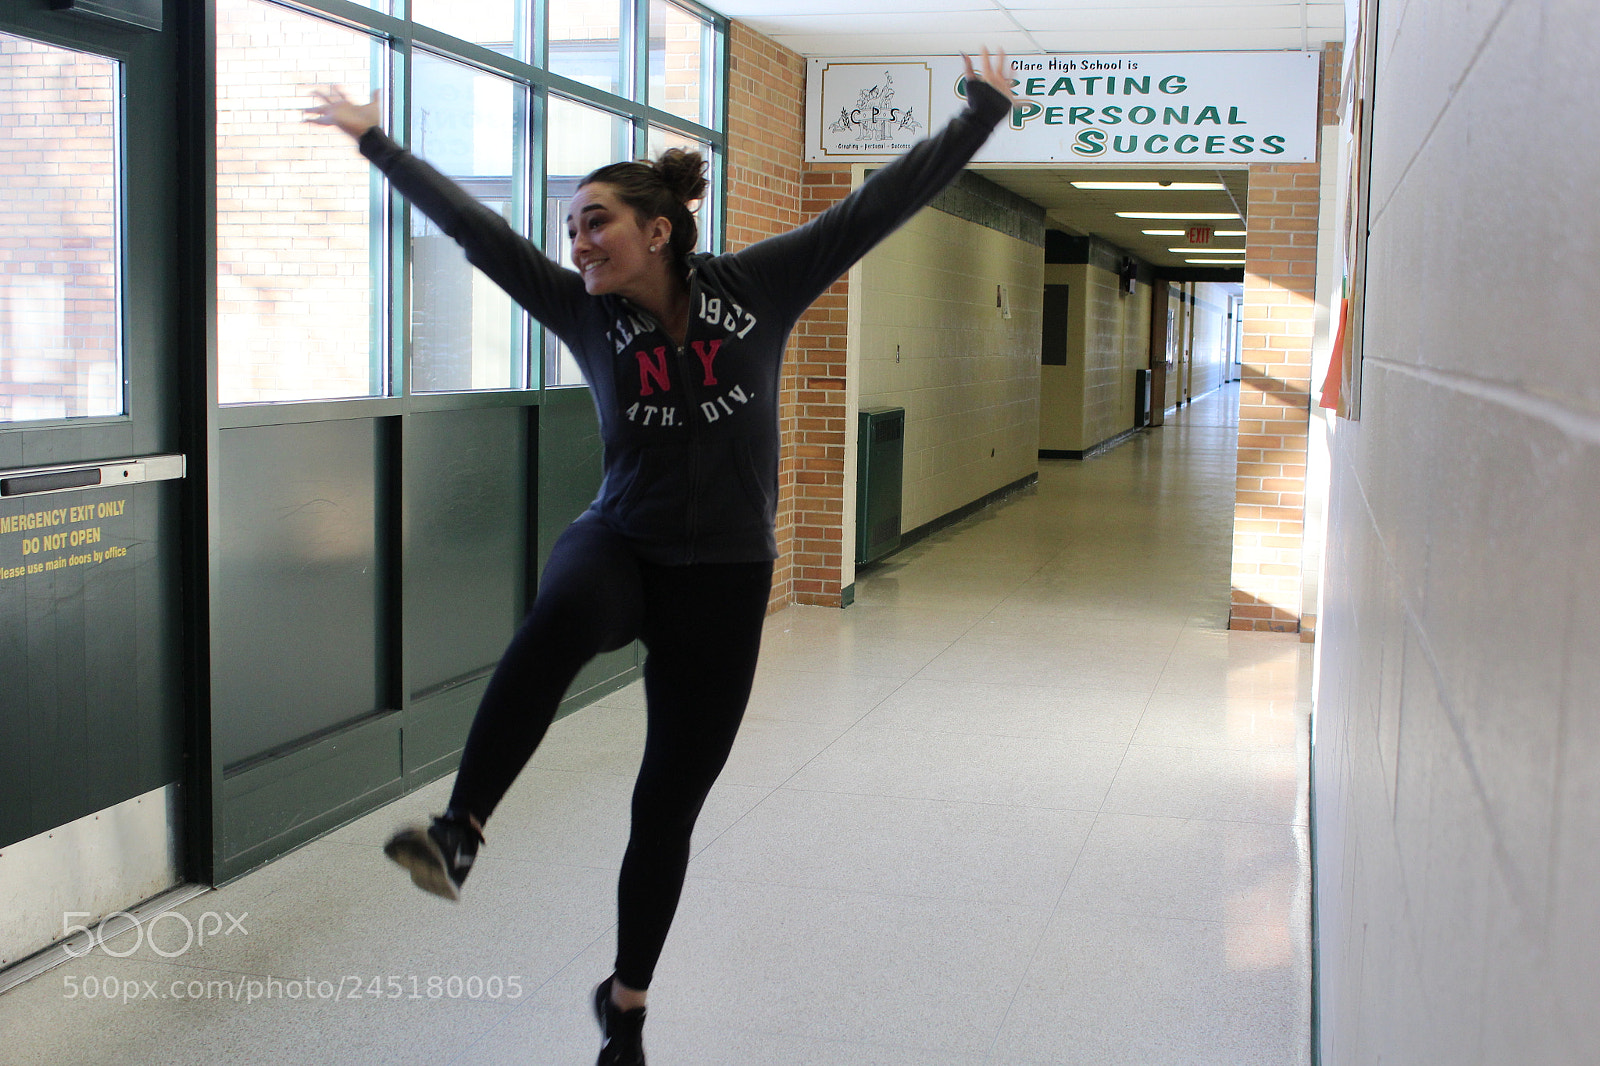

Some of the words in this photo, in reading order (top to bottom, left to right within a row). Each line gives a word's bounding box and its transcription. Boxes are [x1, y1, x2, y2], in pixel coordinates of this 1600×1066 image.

[1011, 60, 1043, 71] Clare
[1048, 59, 1077, 73] High
[1080, 60, 1122, 71] School
[1127, 60, 1138, 70] is
[954, 69, 1188, 101] EATING
[1009, 99, 1247, 131] PERSONAL
[1071, 128, 1286, 157] SUCCESS
[1189, 227, 1211, 244] EXIT
[626, 402, 683, 426] ATH.
[701, 384, 755, 423] DIV.
[0, 508, 67, 534] MERGENCY
[70, 504, 95, 523] EXIT
[97, 499, 126, 519] ONLY
[22, 537, 40, 555] DO
[43, 532, 68, 552] NOT
[69, 527, 101, 547] OPEN
[0, 565, 26, 580] lease
[27, 561, 44, 574] use
[45, 556, 67, 571] main
[68, 553, 92, 567] doors
[93, 547, 104, 564] by
[104, 546, 128, 560] office
